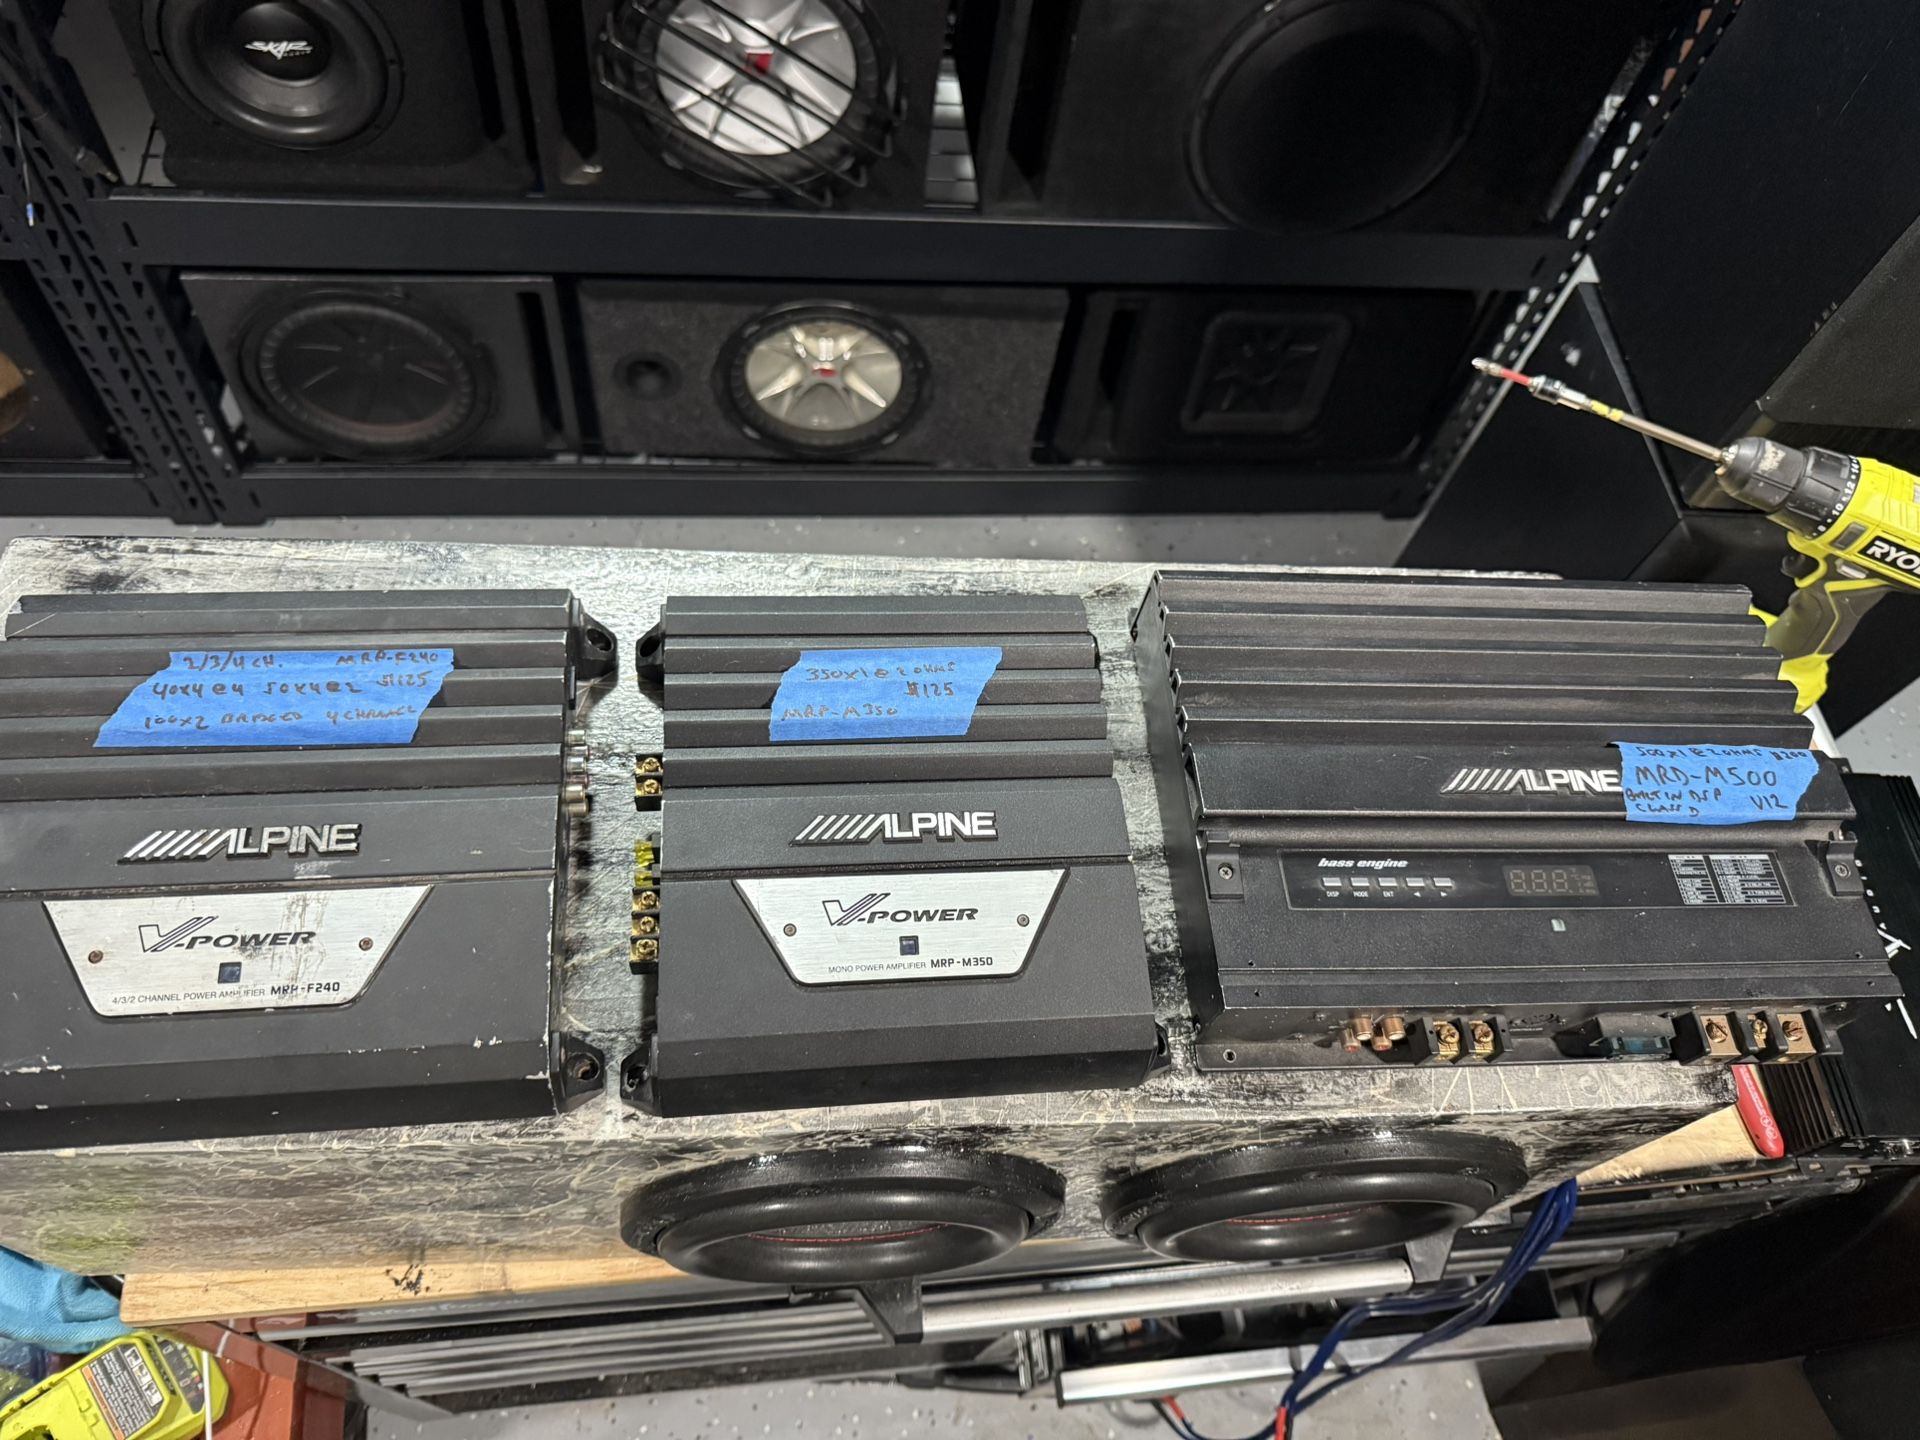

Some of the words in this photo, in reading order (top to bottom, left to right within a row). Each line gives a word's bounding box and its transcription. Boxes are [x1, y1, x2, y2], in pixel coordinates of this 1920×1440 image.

[1832, 503, 1844, 516] 10
[1844, 481, 1856, 497] 12
[1866, 540, 1920, 576] RYO
[1503, 769, 1623, 792] ALPINE
[1635, 765, 1777, 787] MRD-M500
[859, 811, 997, 839] ALPINE
[198, 823, 361, 856] ALPINE
[1318, 858, 1355, 868] bass
[1356, 858, 1409, 870] engine
[822, 892, 979, 926] V-POWER
[138, 916, 316, 953] V-POWER
[828, 965, 853, 974] MONO
[855, 963, 884, 973] POWER
[886, 961, 926, 970] AMPLIFIER
[930, 956, 993, 969] MRP-M350
[112, 995, 136, 1005] 4/3/2
[137, 993, 181, 1003] CHANNEL
[183, 991, 217, 1001] POWER
